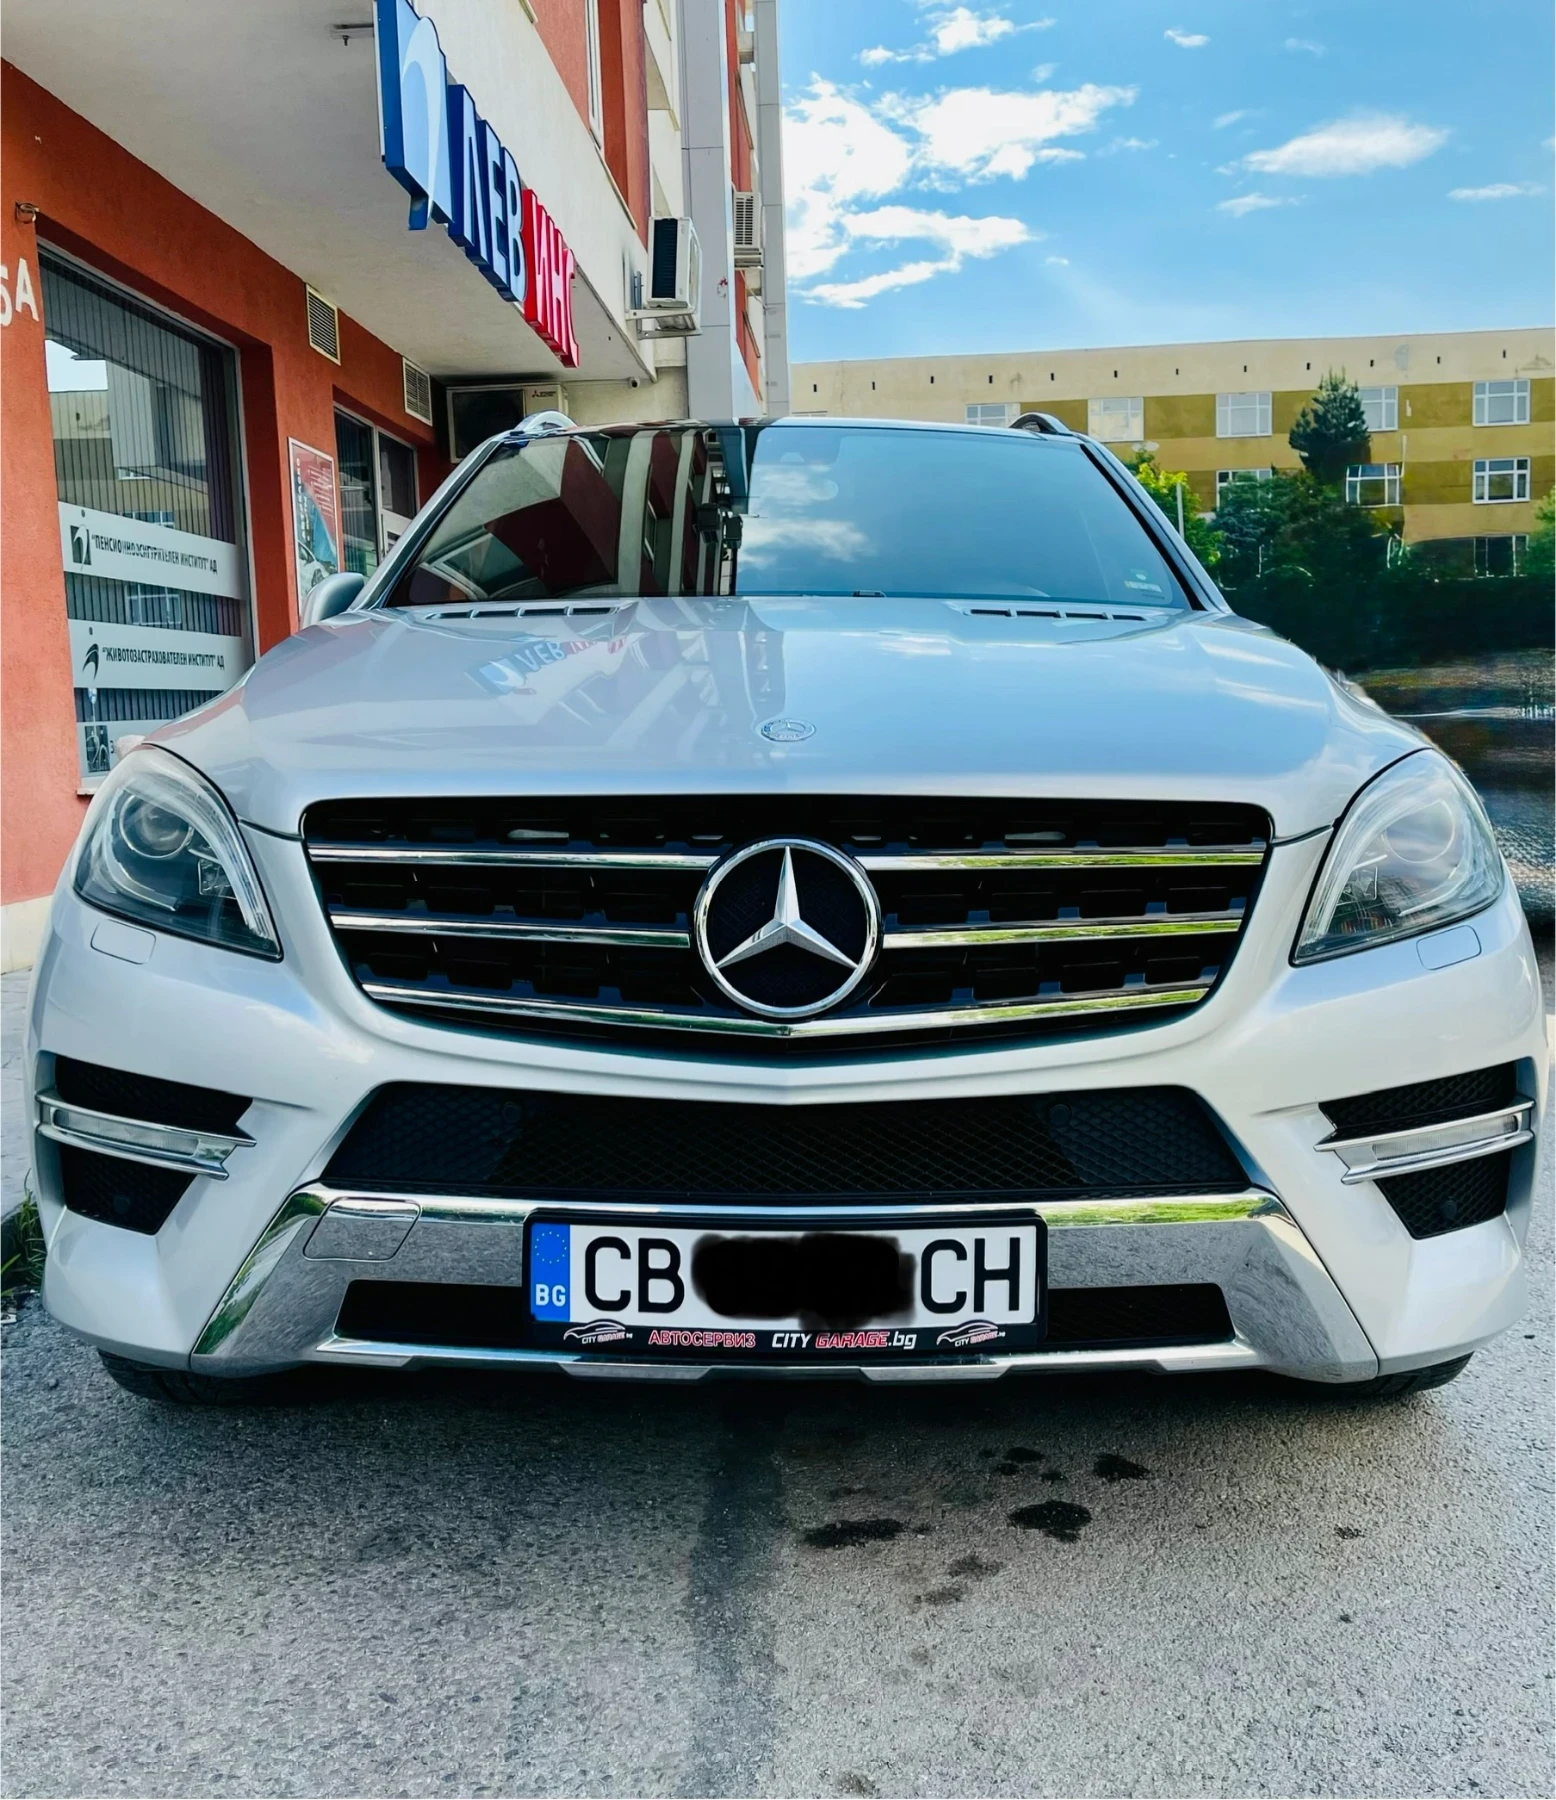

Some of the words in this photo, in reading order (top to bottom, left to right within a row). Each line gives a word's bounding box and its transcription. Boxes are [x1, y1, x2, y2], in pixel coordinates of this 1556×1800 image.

[449, 84, 527, 302] ЛЕВ
[524, 189, 580, 368] ИНС
[217, 655, 225, 671] АД
[535, 1283, 566, 1307] BG
[648, 1329, 756, 1348] АВТОСЕРВИЗ
[771, 1333, 813, 1349] CITY
[815, 1331, 917, 1350] GARAGE.bg
